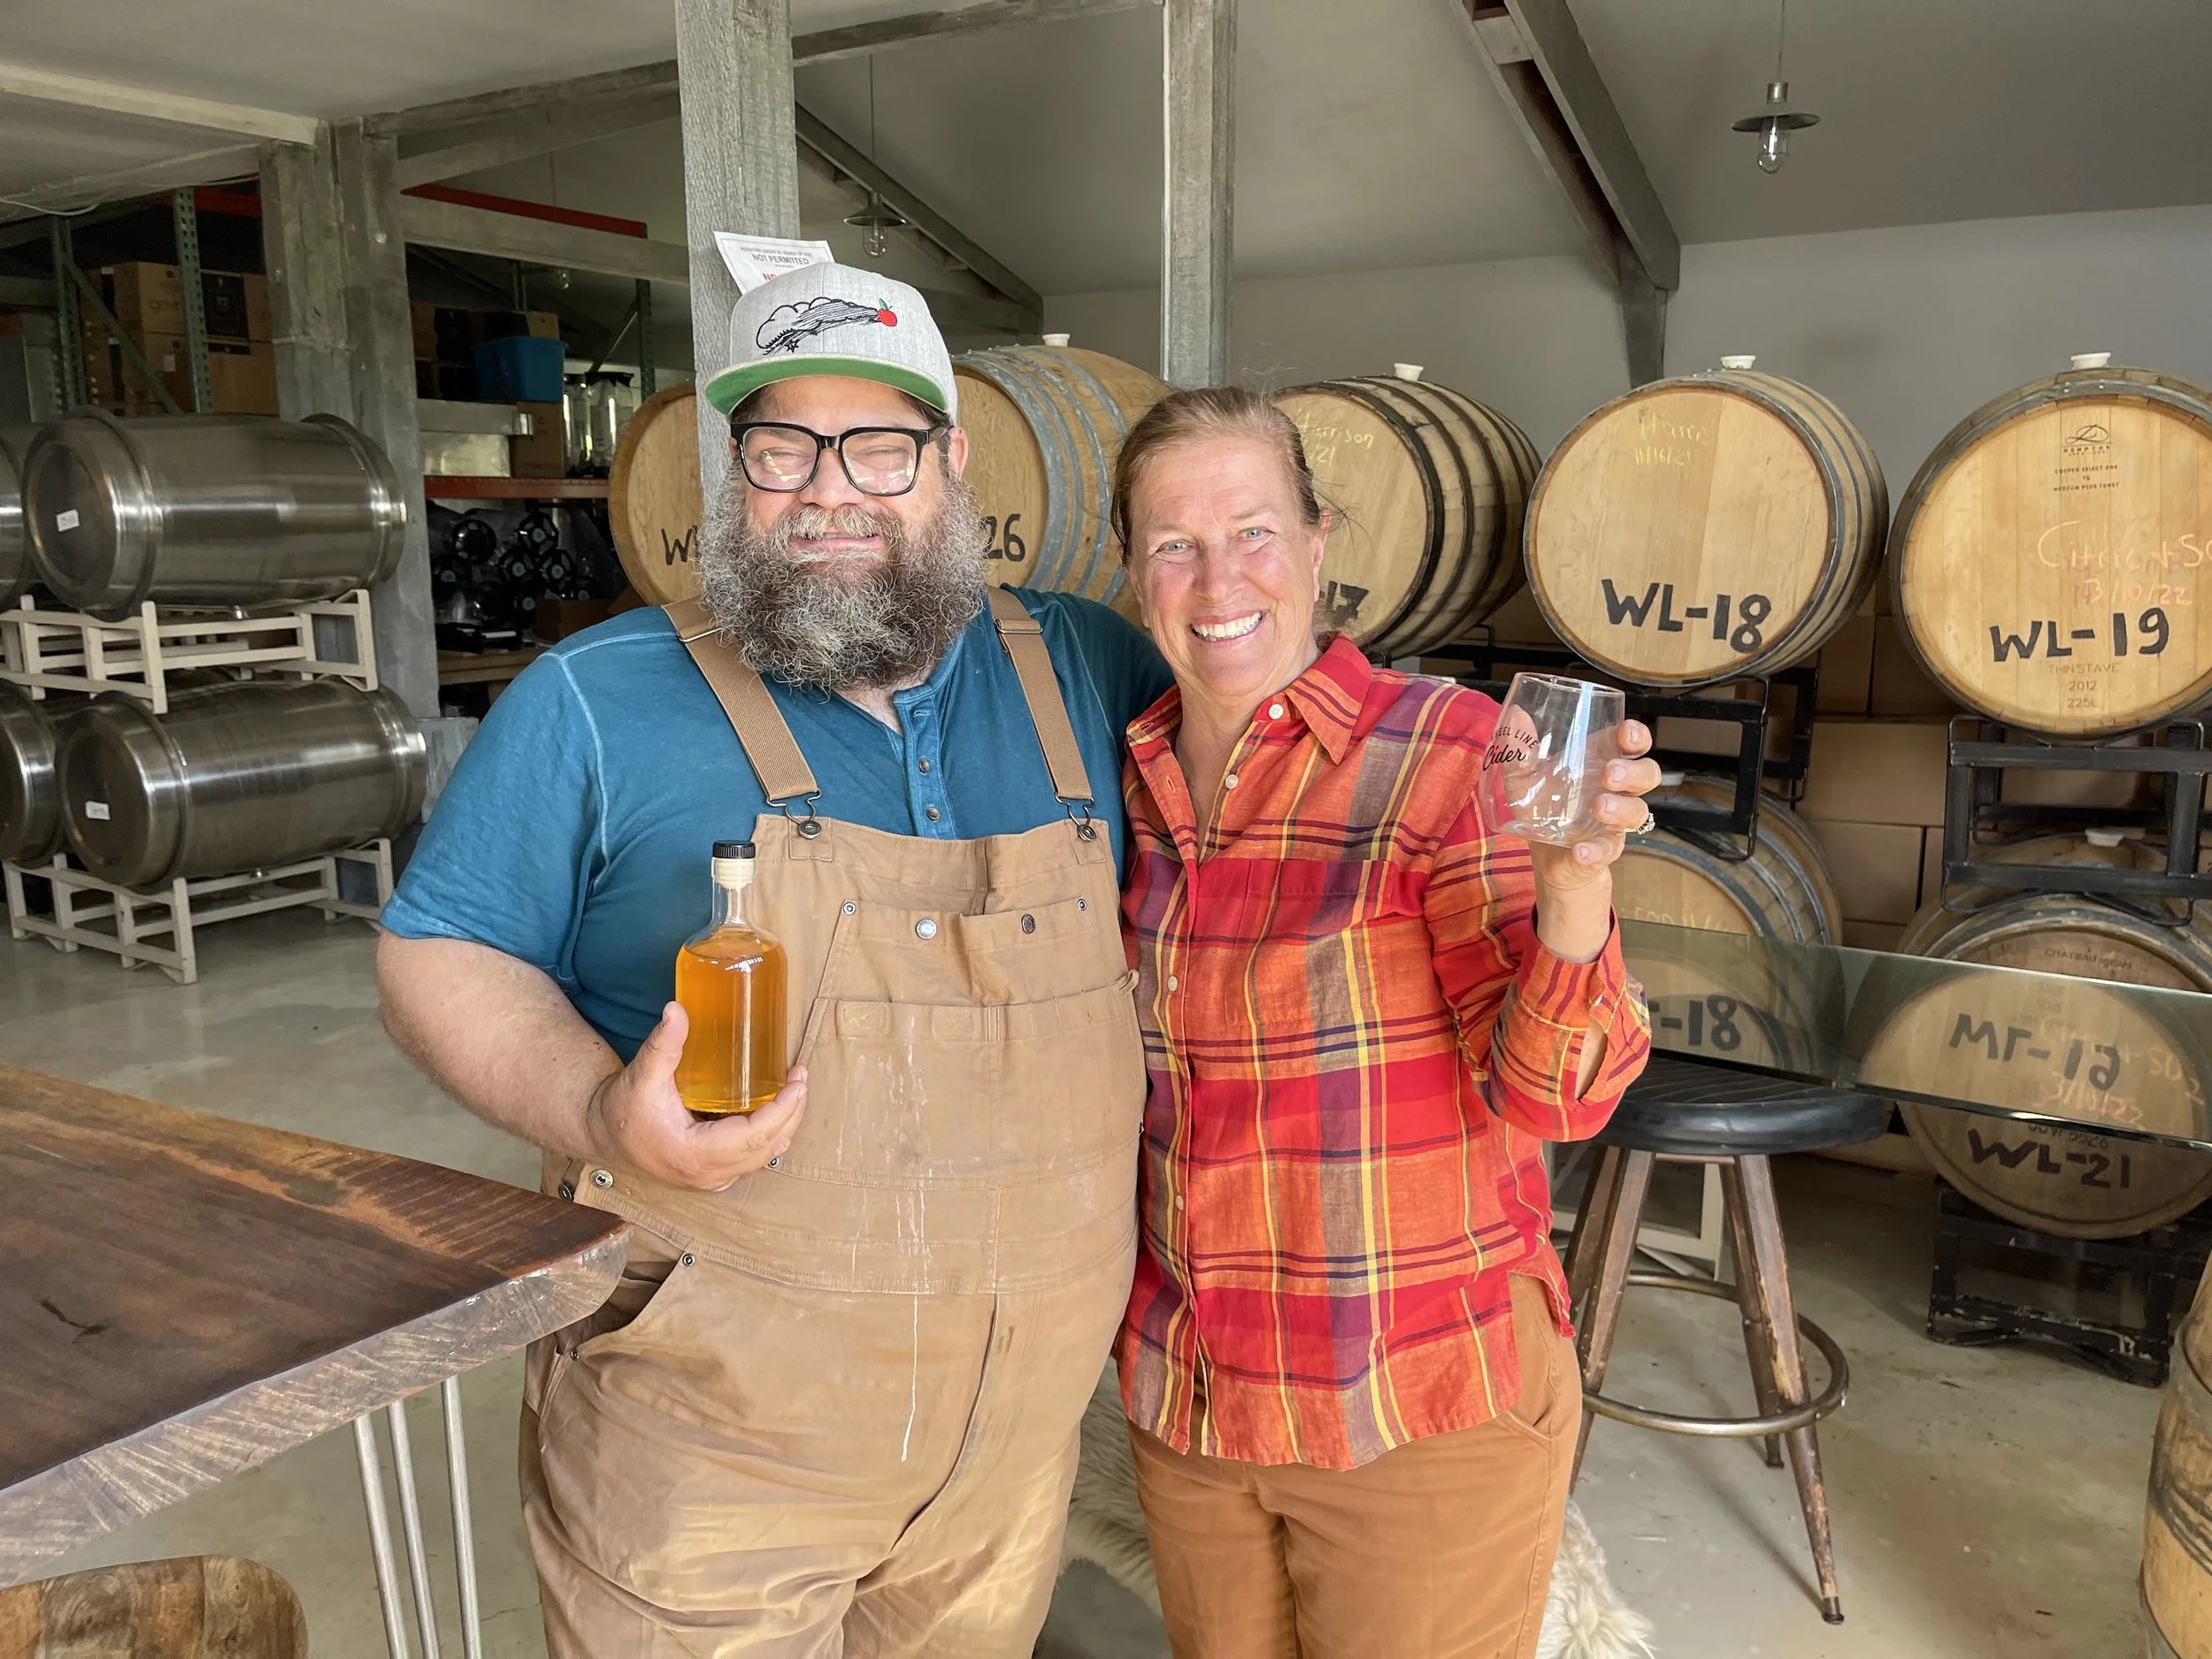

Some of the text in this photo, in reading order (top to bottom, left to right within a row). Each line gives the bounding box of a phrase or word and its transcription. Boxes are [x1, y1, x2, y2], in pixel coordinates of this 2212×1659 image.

[752, 253, 810, 265] NOT PERMITTED
[1319, 580, 1370, 627] 17
[1601, 579, 1772, 654] WL-18
[1989, 607, 2170, 662] WL-19
[2069, 680, 2097, 691] 2012
[2067, 697, 2097, 708] 225L
[1514, 728, 1540, 749] LINE
[1483, 744, 1527, 772] Cider
[1968, 1128, 2131, 1188] WL-21
